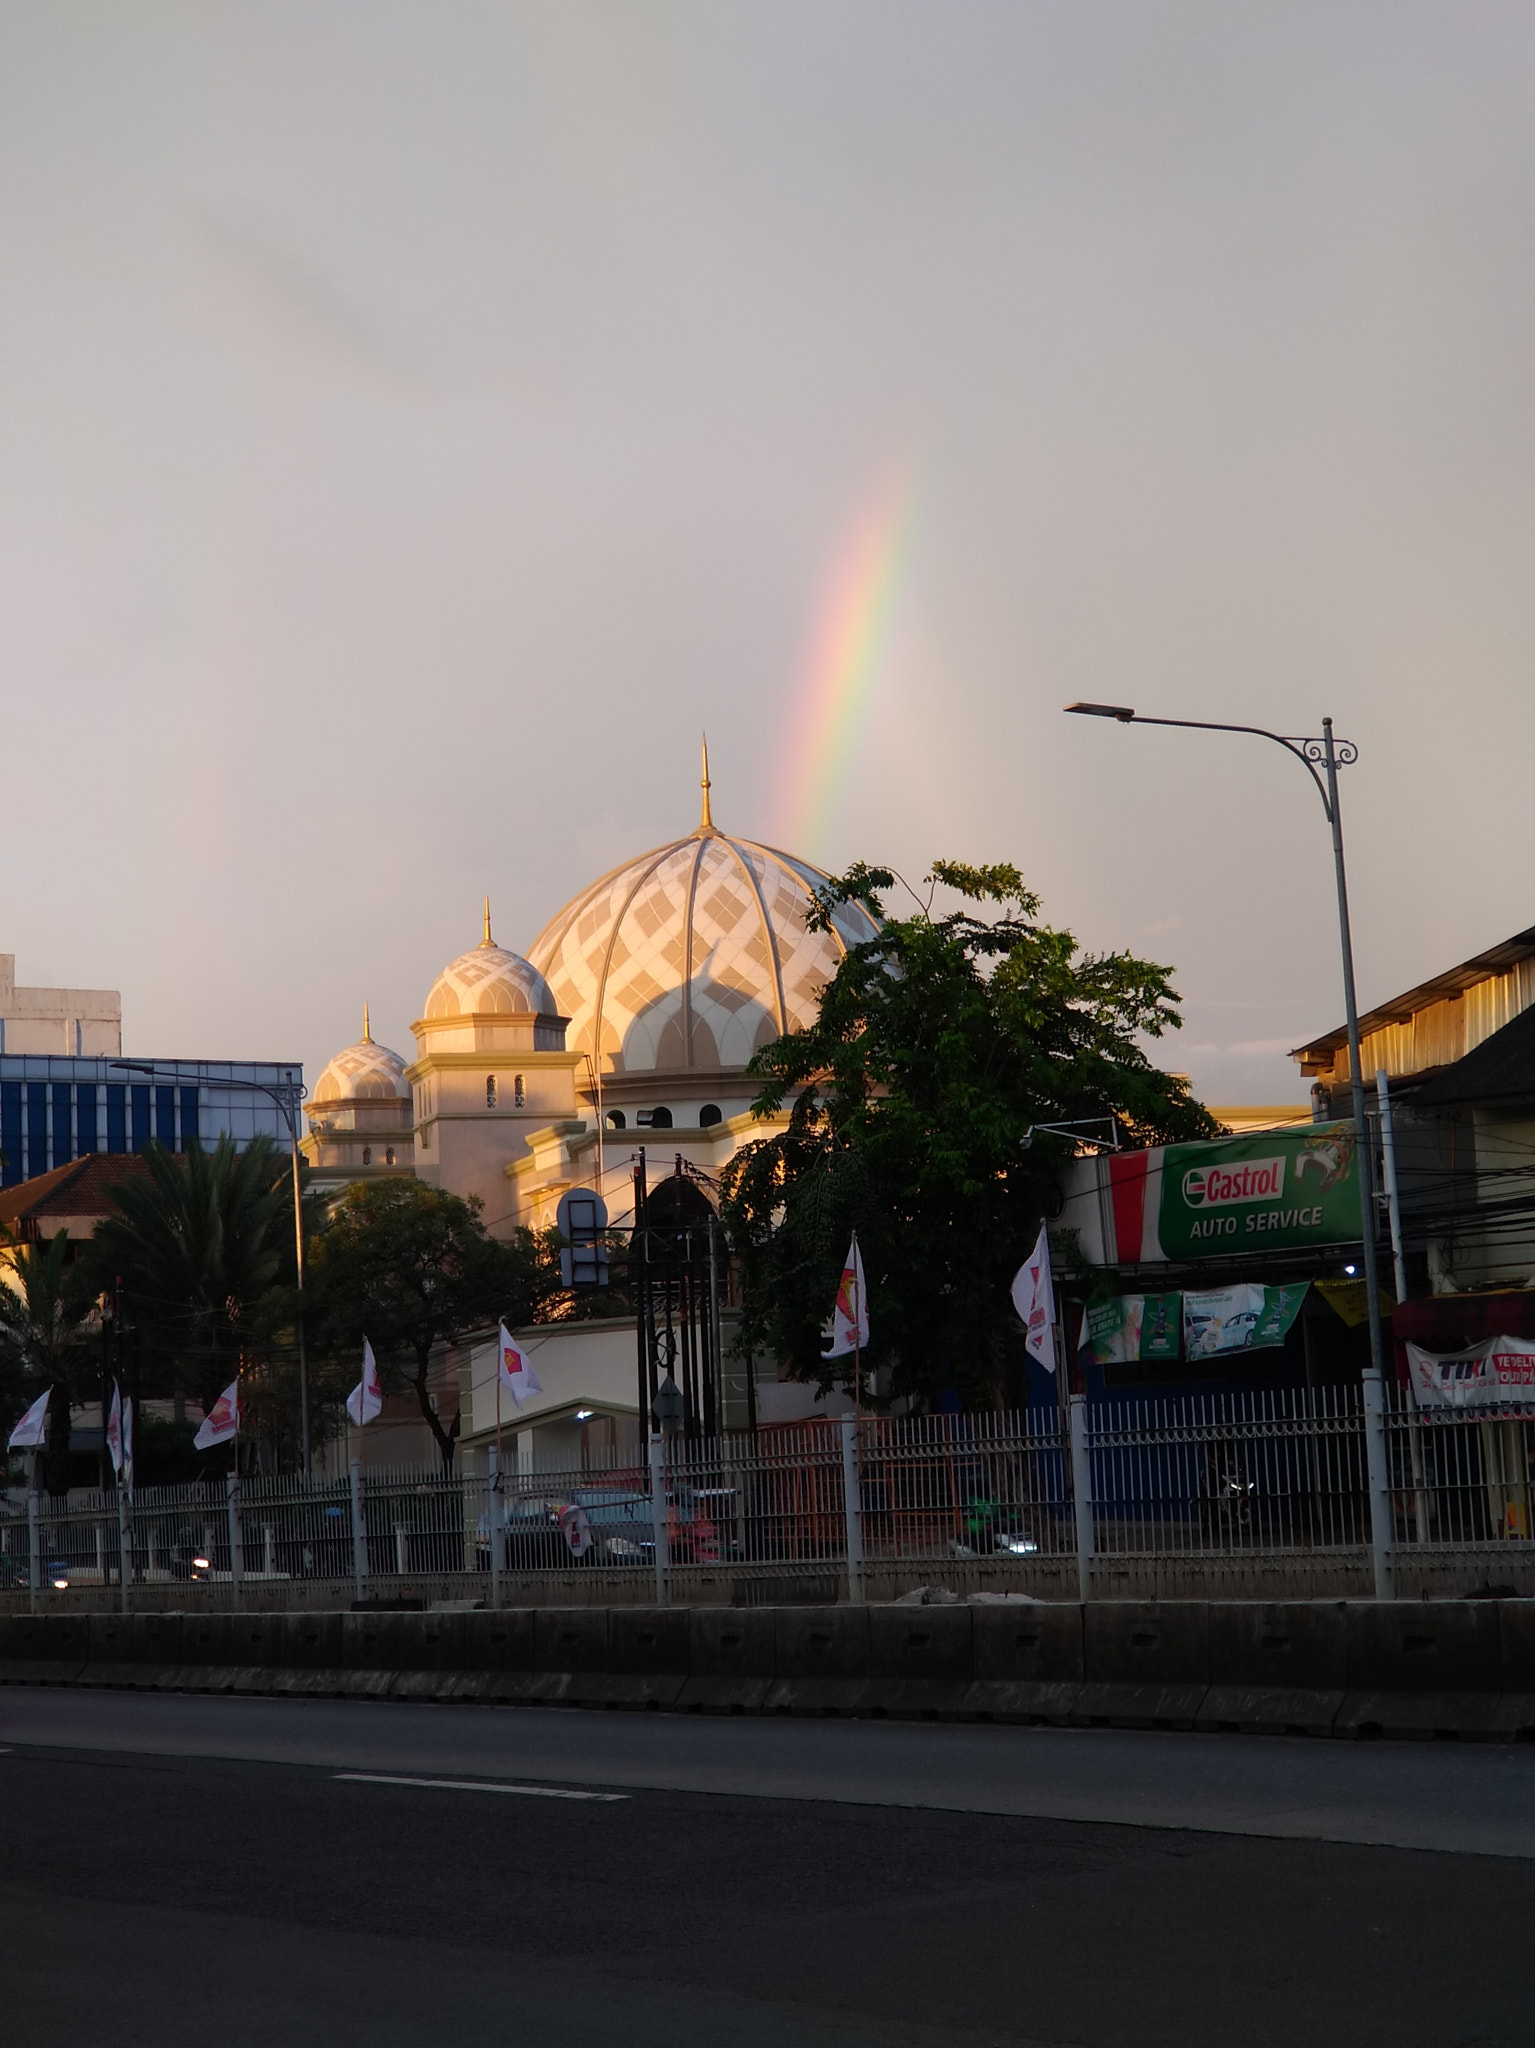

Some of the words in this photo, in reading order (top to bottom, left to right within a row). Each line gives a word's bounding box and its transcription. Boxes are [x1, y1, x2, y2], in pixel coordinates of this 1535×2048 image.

[1207, 1163, 1278, 1202] Castrol
[1189, 1217, 1238, 1239] AUTO
[1245, 1206, 1323, 1233] SERVICE
[1437, 1357, 1488, 1380] TIKI
